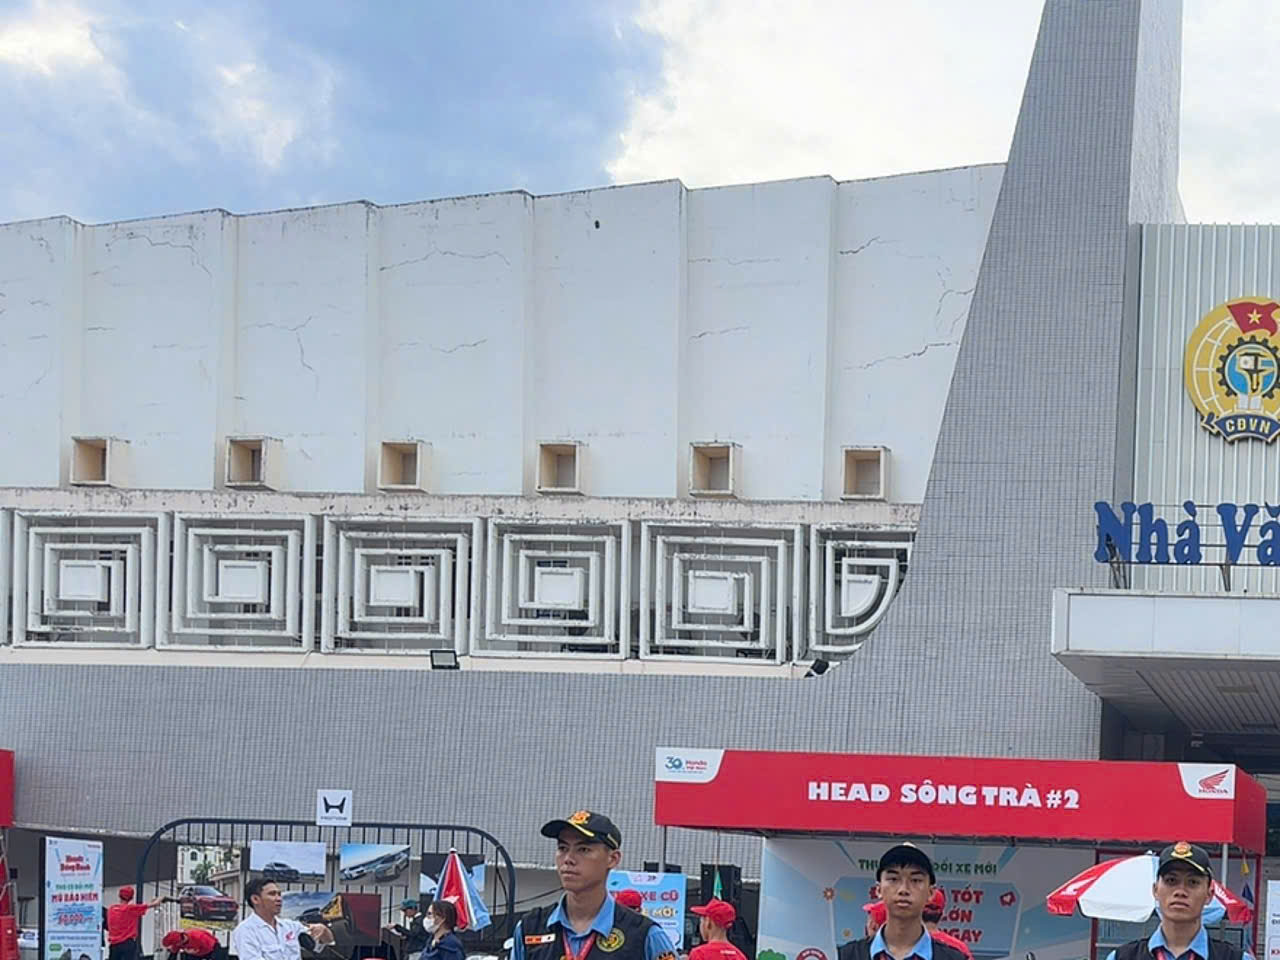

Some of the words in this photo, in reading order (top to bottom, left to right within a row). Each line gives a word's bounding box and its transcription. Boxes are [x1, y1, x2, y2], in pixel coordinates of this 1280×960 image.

[1225, 416, 1272, 434] CĐVN
[1094, 501, 1202, 564] Nhà
[808, 781, 890, 803] HEAD
[900, 779, 977, 805] SÔNG
[982, 779, 1041, 808] TRÀ
[1046, 788, 1080, 810] #2
[951, 884, 984, 905] TỐT
